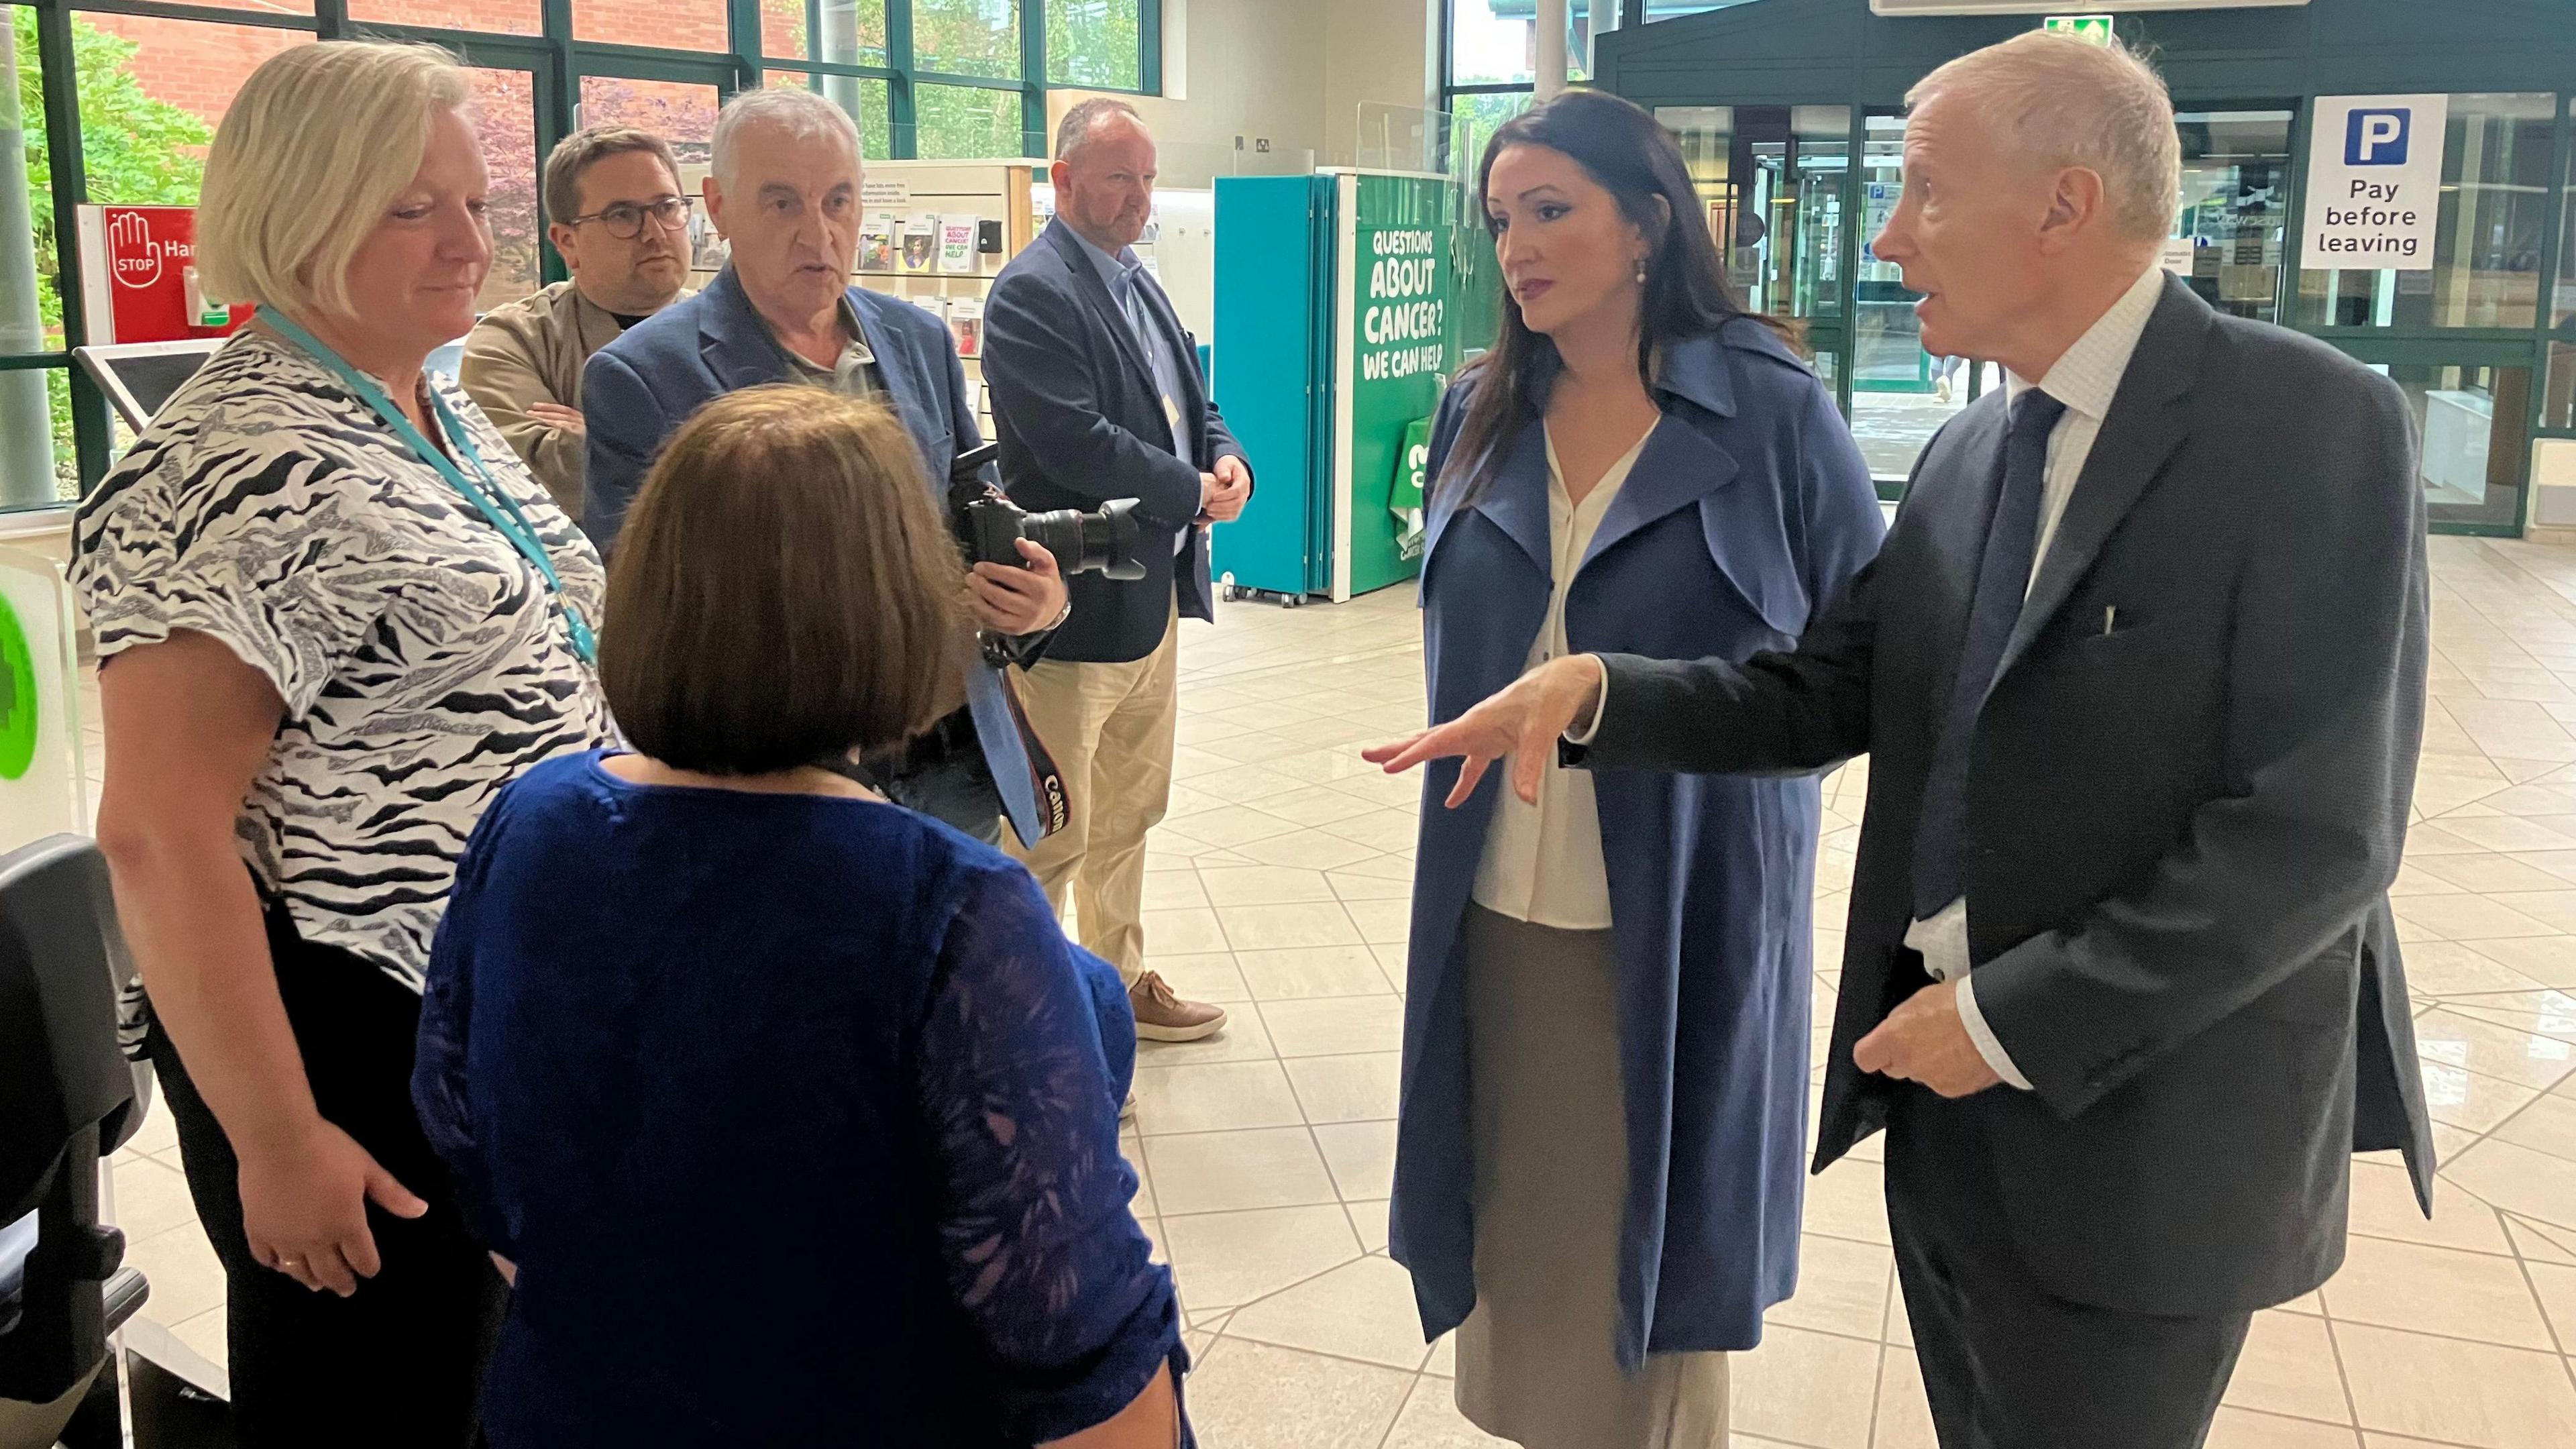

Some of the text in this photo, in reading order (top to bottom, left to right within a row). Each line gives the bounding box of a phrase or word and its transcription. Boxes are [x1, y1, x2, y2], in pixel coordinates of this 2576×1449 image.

[2359, 114, 2401, 161] P
[2350, 179, 2399, 203] Pay
[2326, 207, 2416, 225] before
[1373, 230, 1433, 256] QUESTIONS
[2319, 233, 2418, 256] leaving
[118, 258, 155, 271] STOP
[1370, 257, 1436, 299] ABOUT
[1364, 299, 1443, 345] CANCER?
[1363, 343, 1443, 380] WE CAN HELP
[1045, 774, 1064, 833] Canon
